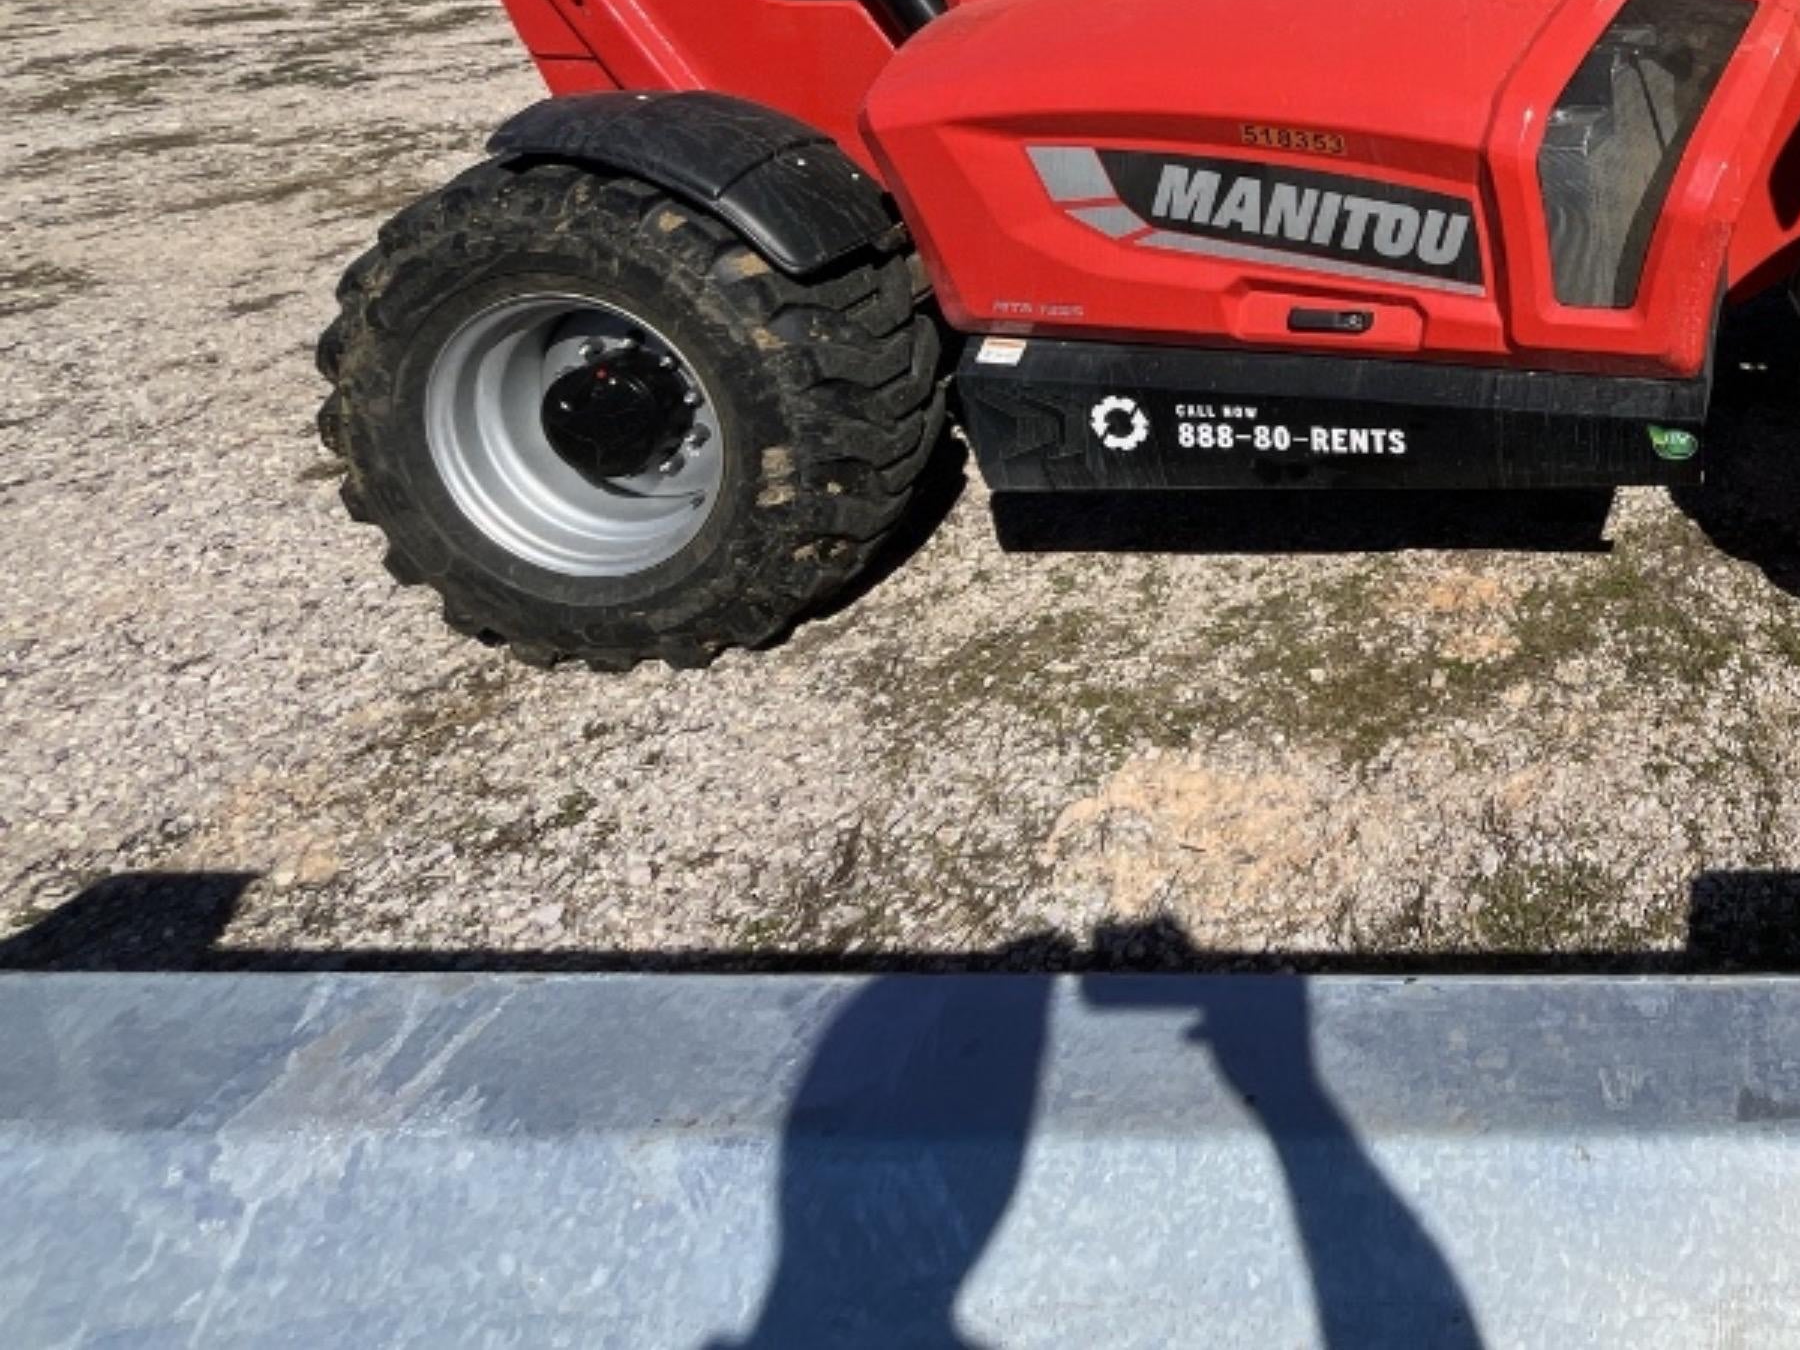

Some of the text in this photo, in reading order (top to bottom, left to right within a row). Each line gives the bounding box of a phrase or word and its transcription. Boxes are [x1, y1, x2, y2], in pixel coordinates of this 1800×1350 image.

[1151, 163, 1470, 266] MANITOU
[1175, 404, 1258, 419] CALL NOW
[1178, 422, 1407, 454] 888-80-RENTS
